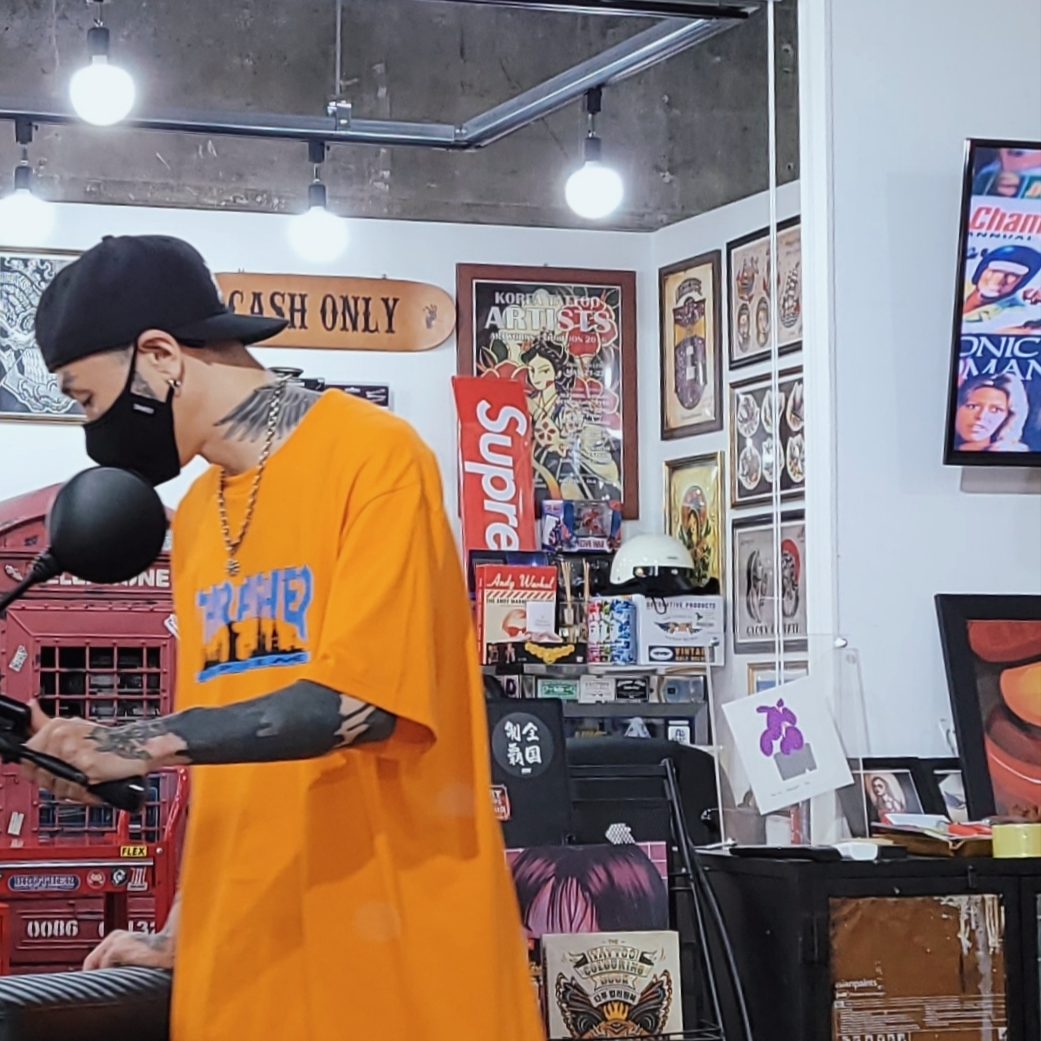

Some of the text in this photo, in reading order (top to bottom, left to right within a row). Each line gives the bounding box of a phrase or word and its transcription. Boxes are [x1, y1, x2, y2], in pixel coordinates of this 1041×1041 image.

[495, 291, 542, 306] KOREA
[229, 290, 399, 334] CASH ONLY
[484, 305, 611, 333] ARTISTS
[959, 357, 1041, 380] MAN
[486, 573, 555, 591] Andy Warhol
[121, 846, 146, 857] FLEX
[27, 919, 79, 938] 0086
